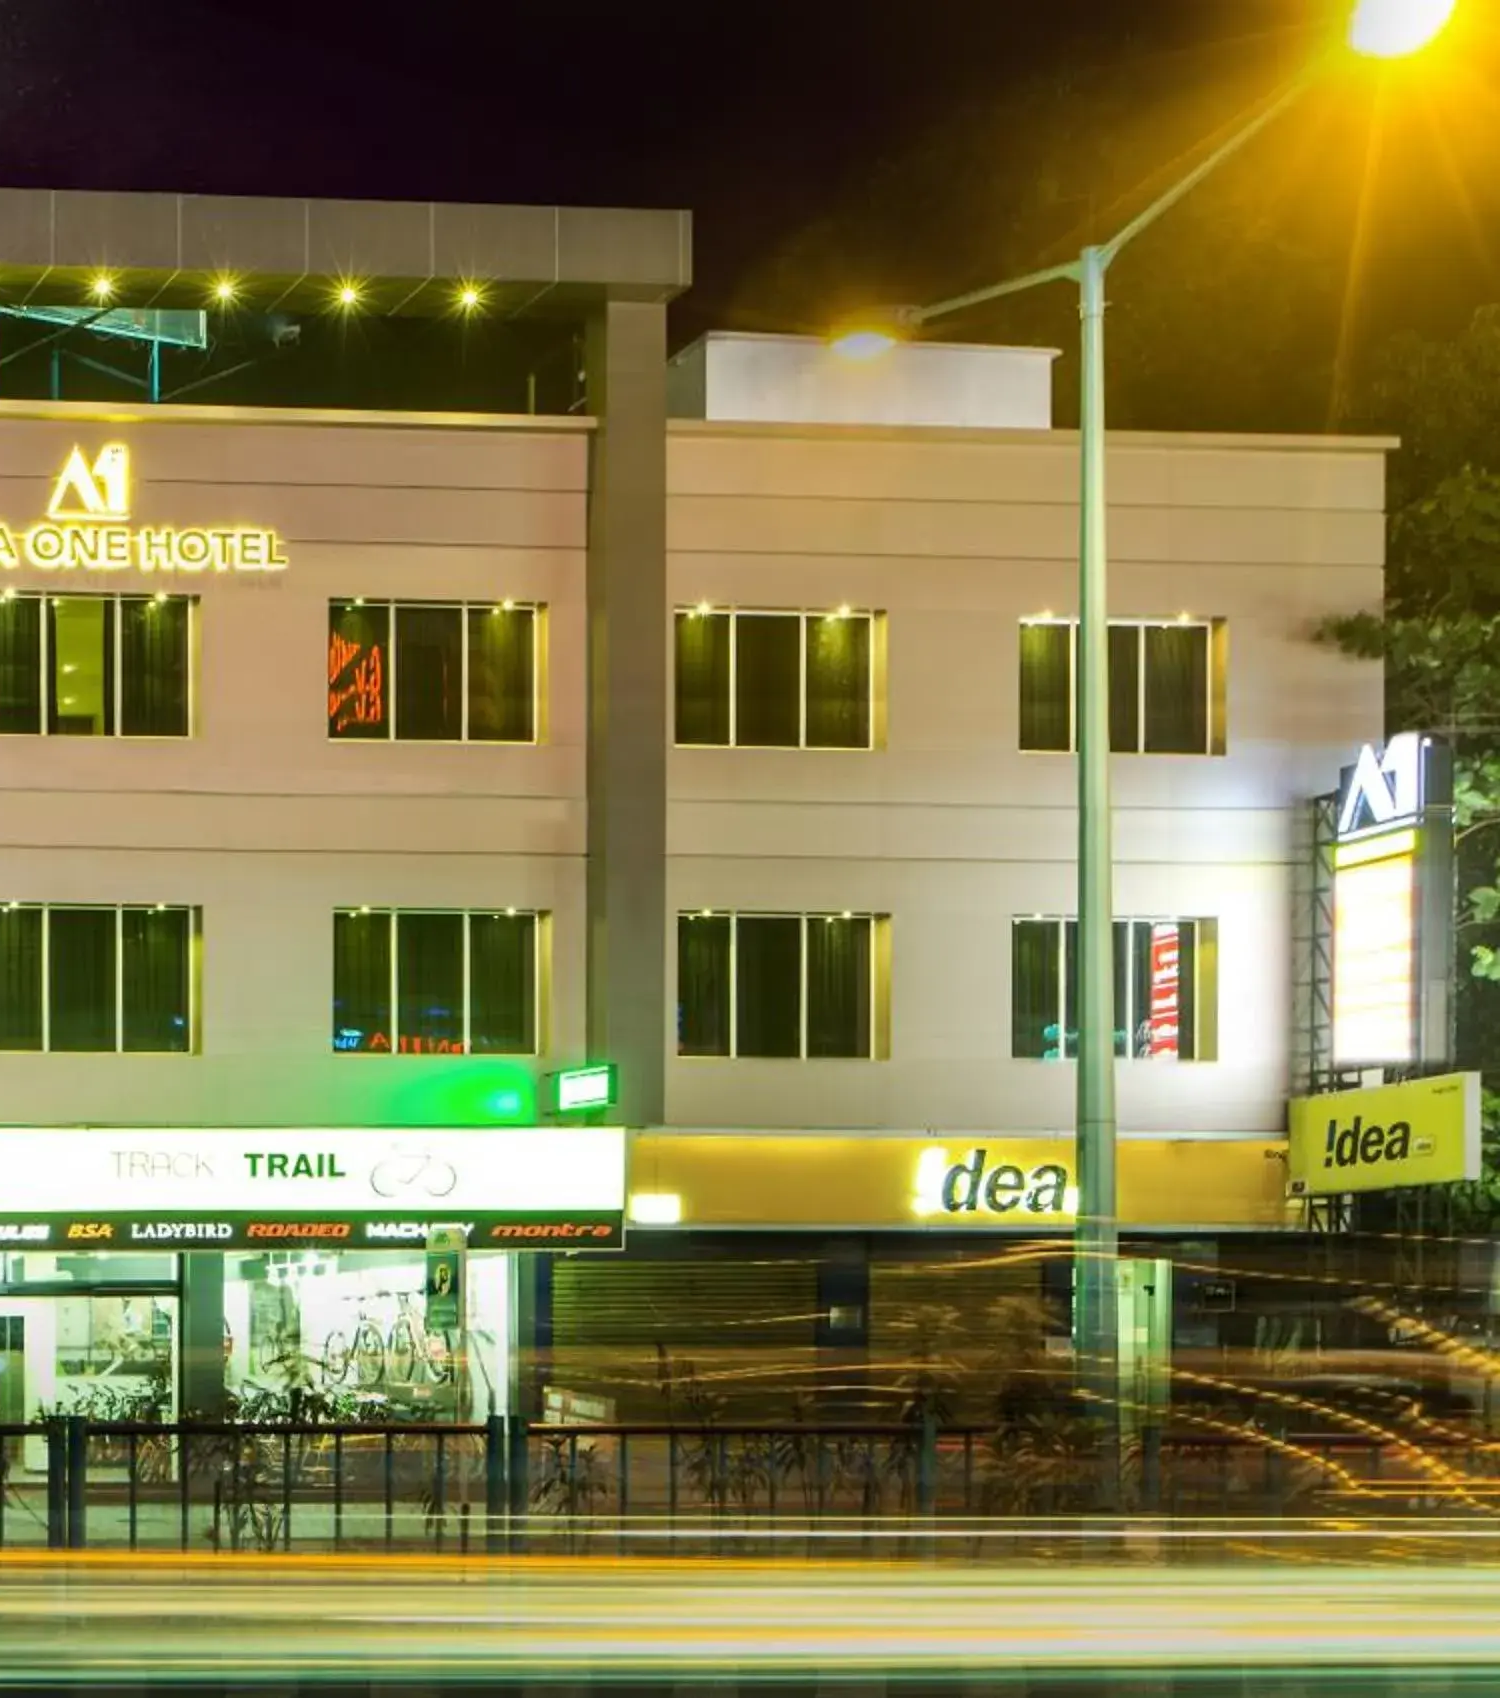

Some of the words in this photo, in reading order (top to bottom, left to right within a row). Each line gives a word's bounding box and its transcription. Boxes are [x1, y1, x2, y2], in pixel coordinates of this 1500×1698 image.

[30, 526, 130, 565] ONE
[143, 528, 288, 567] HOTEL
[108, 1150, 215, 1180] TRACK
[243, 1152, 347, 1179] TRAIL
[67, 1222, 114, 1239] BSA
[130, 1222, 233, 1240] LADYBIRD
[365, 1222, 475, 1239] MACHY
[490, 1221, 614, 1239] montra
